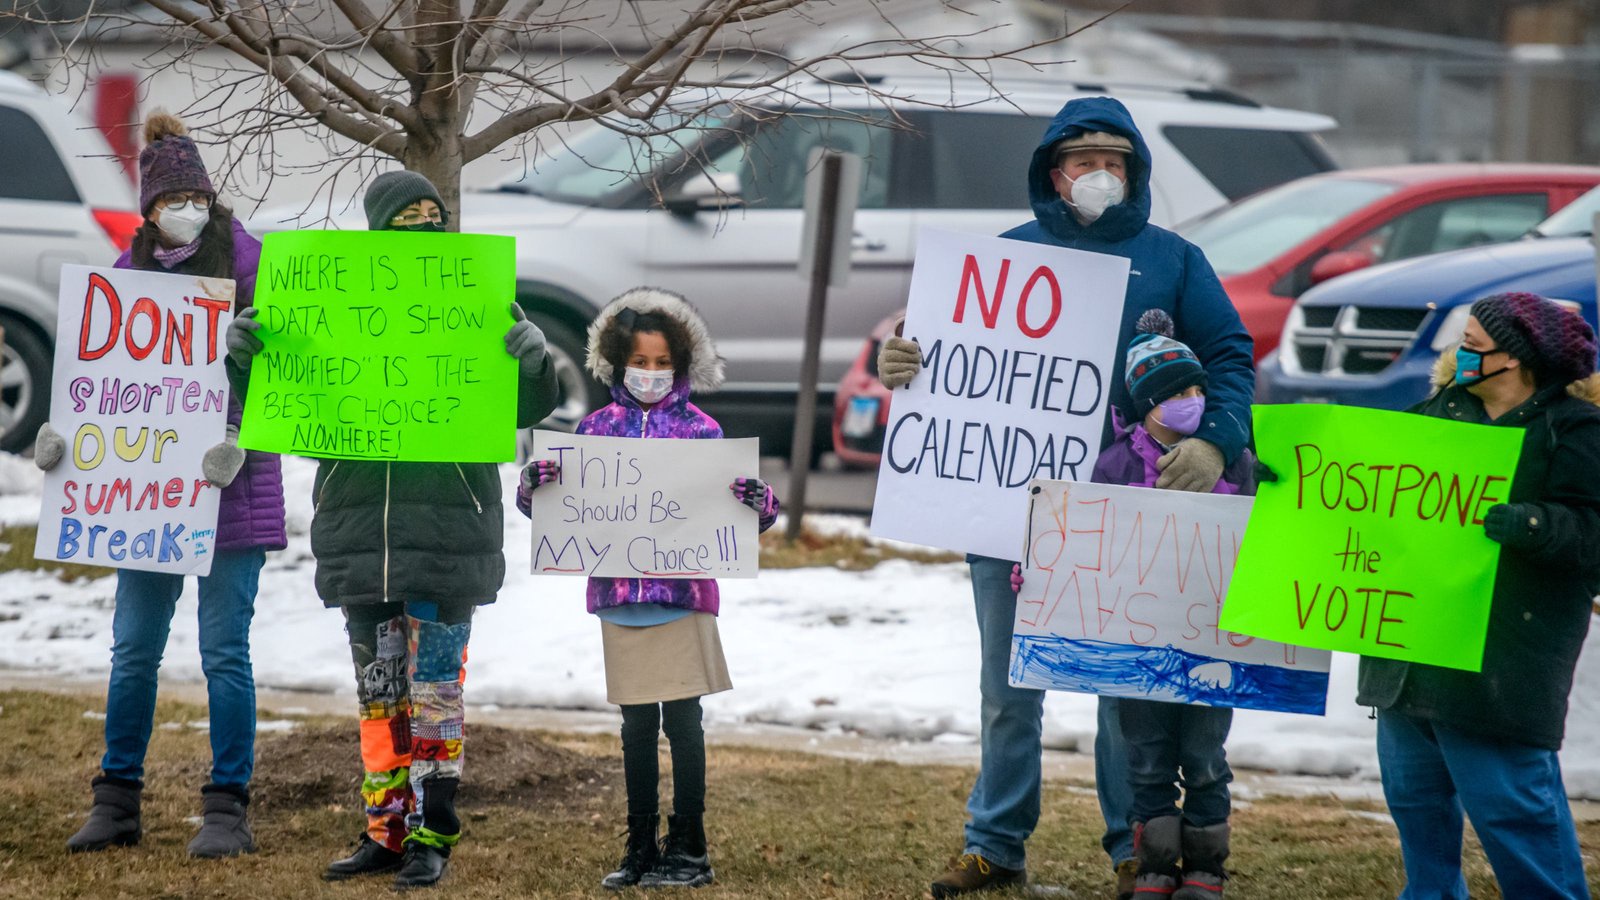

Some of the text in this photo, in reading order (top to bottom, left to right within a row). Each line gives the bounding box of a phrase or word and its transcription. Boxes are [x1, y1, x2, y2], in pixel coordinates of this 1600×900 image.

[269, 254, 477, 293] WHERE IS THE
[952, 253, 1063, 339] NO
[267, 304, 486, 338] DATA TO SHOW
[262, 351, 481, 388] "MODIFIED" IS THE
[904, 336, 1102, 417] MODIFIED
[263, 391, 461, 426] BEST CHOICE?
[292, 423, 403, 456] NOWHERE!
[887, 412, 1088, 490] CALENDAR
[547, 446, 642, 489] This
[1294, 443, 1508, 528] POSTPONE
[563, 490, 688, 524] Should Be
[627, 525, 740, 574] Choice!!!
[1333, 526, 1382, 574] the
[1020, 569, 1159, 645] SAVE
[1294, 580, 1416, 649] VOTE
